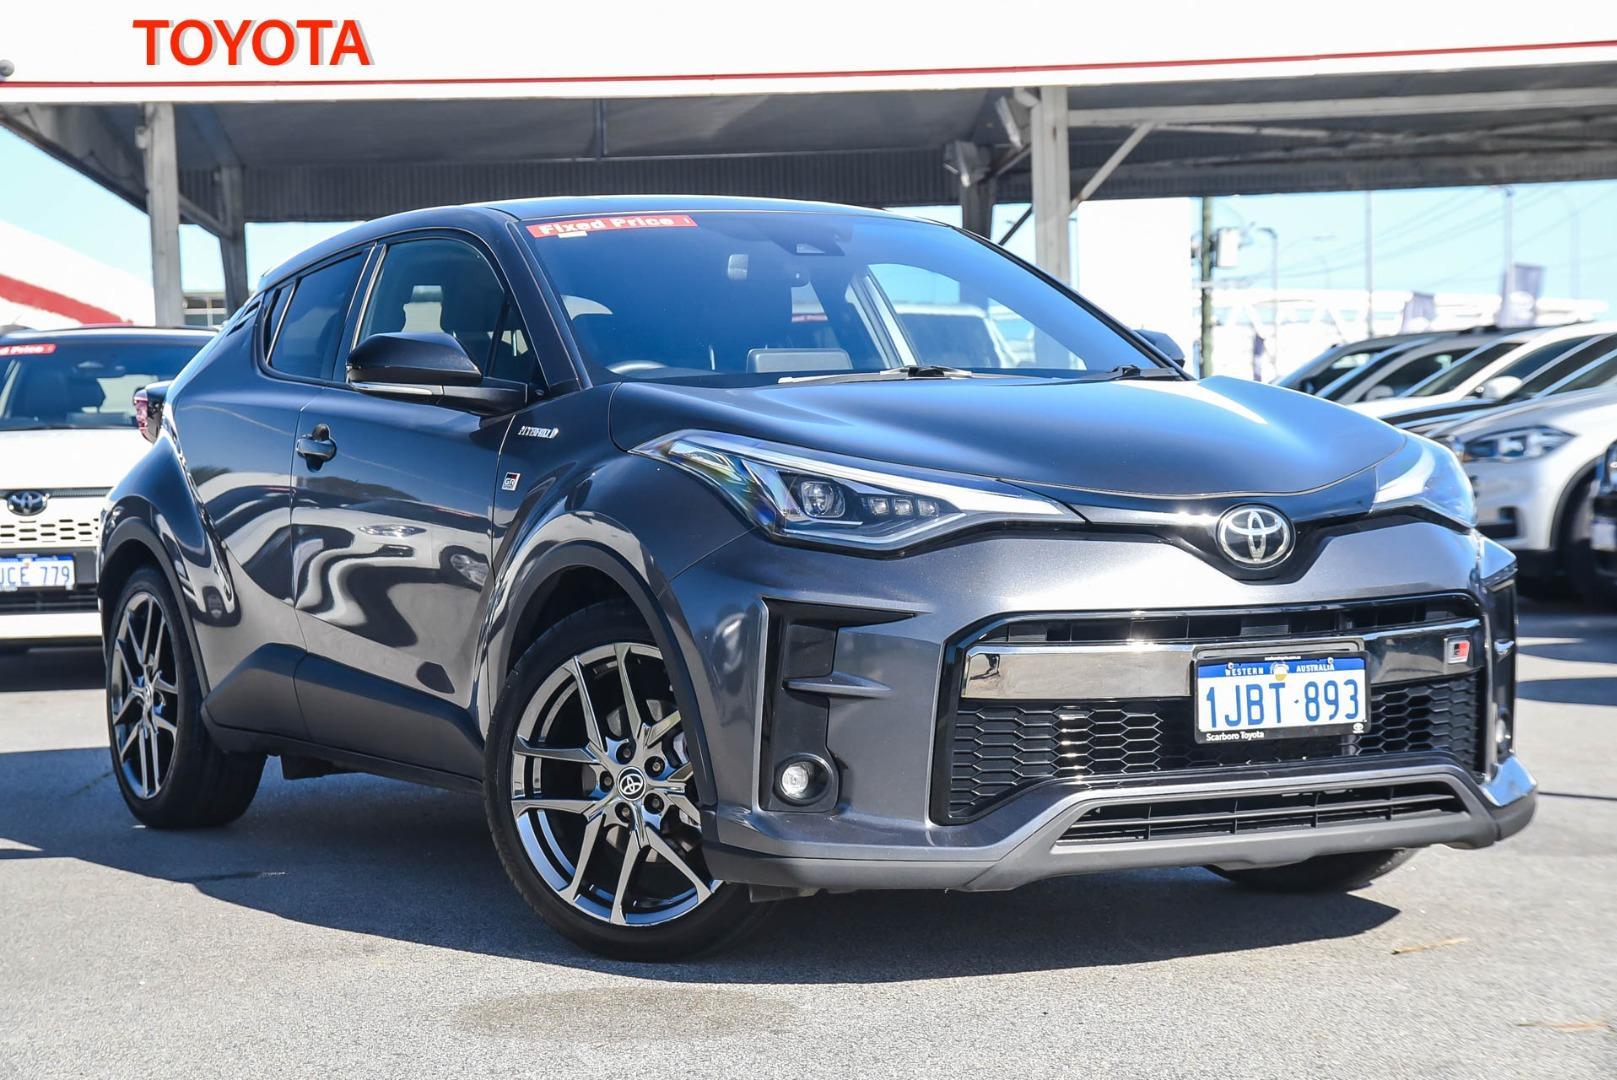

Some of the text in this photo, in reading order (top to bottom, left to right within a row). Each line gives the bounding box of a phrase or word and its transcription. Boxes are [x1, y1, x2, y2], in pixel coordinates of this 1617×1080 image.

[132, 19, 373, 66] TOYOTA
[538, 215, 675, 236] Fixed Price
[40, 565, 70, 585] 779
[1225, 663, 1335, 677] WESTERN AUSTRALIA
[1206, 730, 1264, 741] Scarboro Toyota
